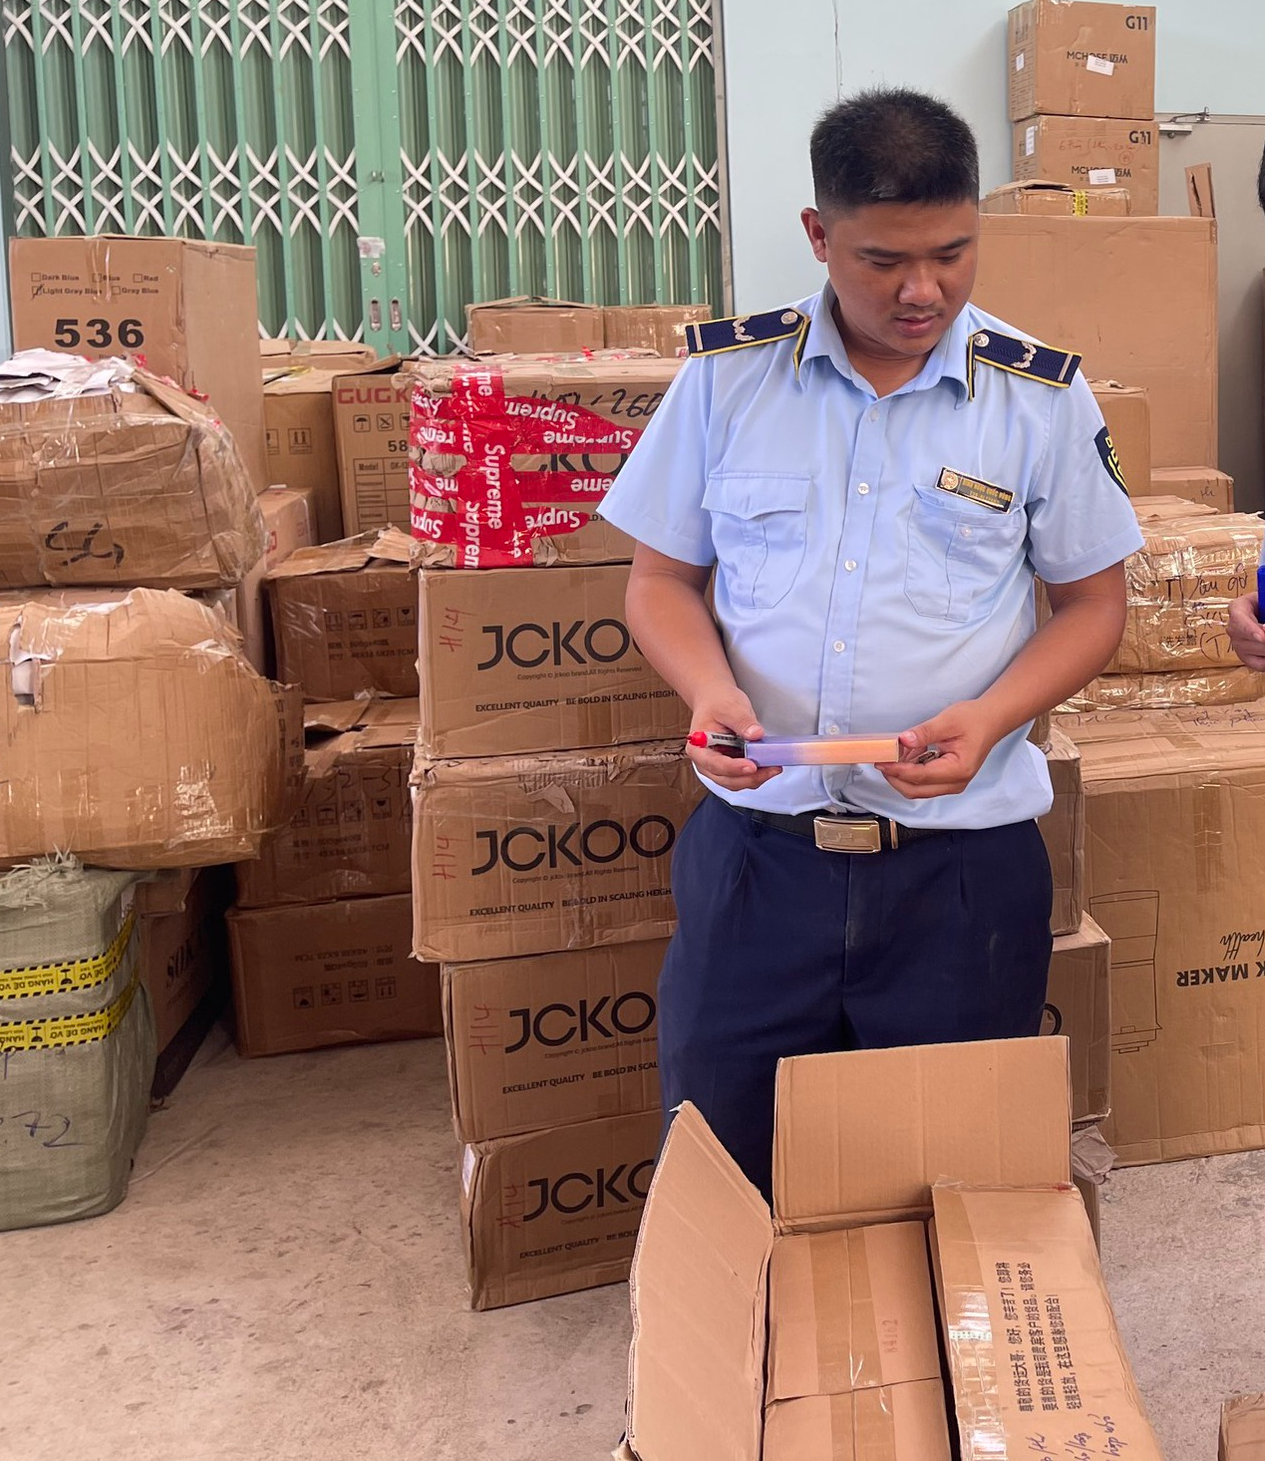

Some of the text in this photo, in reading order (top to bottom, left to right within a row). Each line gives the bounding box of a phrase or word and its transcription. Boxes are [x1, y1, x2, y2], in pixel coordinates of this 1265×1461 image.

[1125, 15, 1148, 30] G11
[42, 288, 63, 296] Light
[65, 288, 83, 296] Gray
[54, 318, 145, 349] 536
[483, 443, 506, 530] Supreme
[517, 672, 548, 681] Copyright
[597, 667, 616, 676] Rights
[616, 666, 642, 674] Reserved
[475, 702, 522, 713] EXCELLENT
[522, 698, 559, 709] QUALITY
[565, 697, 577, 706] BE
[577, 695, 601, 705] BOLD
[601, 694, 611, 703] IN
[612, 691, 649, 702] SCALING
[472, 815, 676, 876] JCKOO
[512, 876, 541, 884] Copyright
[470, 905, 517, 917] EXCELLENT
[518, 901, 555, 912] QUALITY
[598, 894, 608, 903] IN
[609, 891, 645, 902] SCALING
[1219, 930, 1265, 961] health
[1176, 962, 1249, 988] MAKER
[502, 1080, 549, 1094] EXCELLENT
[549, 1074, 586, 1087] QUALITY
[592, 1071, 602, 1079] BE
[604, 1067, 626, 1077] BOLD
[519, 1244, 564, 1259] EXCELLENT
[564, 1238, 600, 1250] QUALITY
[606, 1233, 617, 1241] BE
